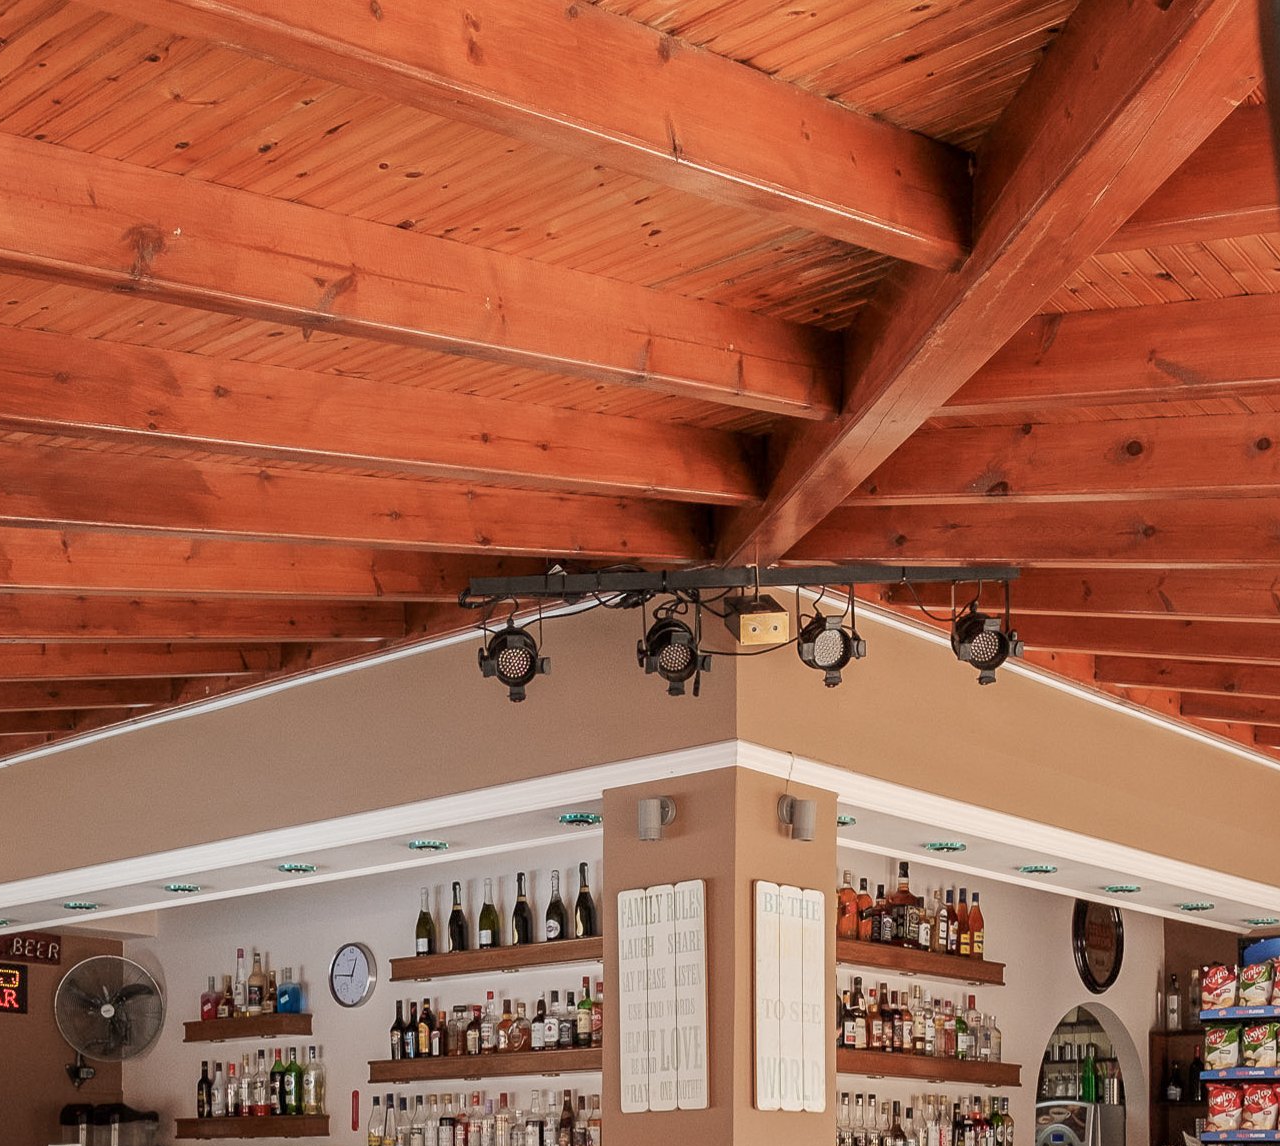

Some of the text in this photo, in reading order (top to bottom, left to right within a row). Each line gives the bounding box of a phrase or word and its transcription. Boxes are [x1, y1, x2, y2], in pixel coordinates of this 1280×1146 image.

[621, 893, 662, 928] FAMILY
[762, 891, 821, 921] BE THE
[12, 937, 60, 960] BEER
[621, 930, 703, 960] LAUGH SHARE
[637, 967, 667, 991] PLEASE
[762, 998, 821, 1025] TO SEE
[660, 1025, 703, 1072] LOVE
[760, 1055, 821, 1101] WORLD
